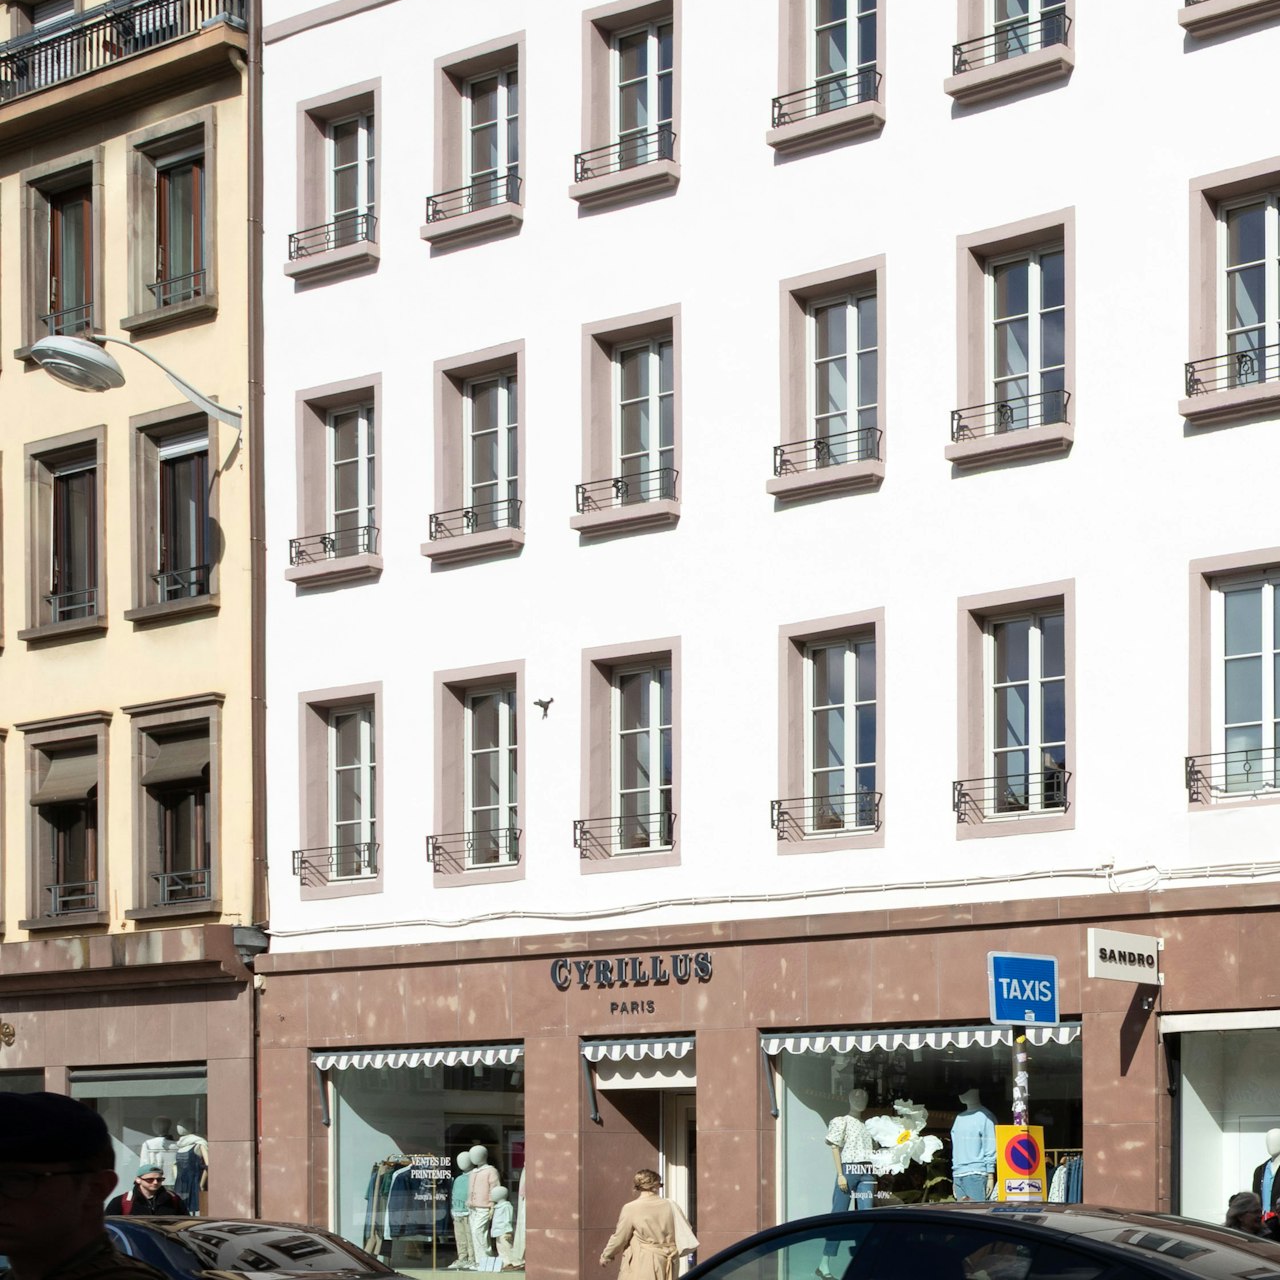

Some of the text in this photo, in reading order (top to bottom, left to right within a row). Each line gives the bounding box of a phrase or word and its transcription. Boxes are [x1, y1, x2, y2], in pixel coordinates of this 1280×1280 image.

[1099, 948, 1155, 967] SANDRO
[550, 952, 712, 989] CYRILLUS
[999, 978, 1052, 1002] TAXIS
[610, 1000, 656, 1015] PARIS
[411, 1157, 451, 1166] VENTES DE
